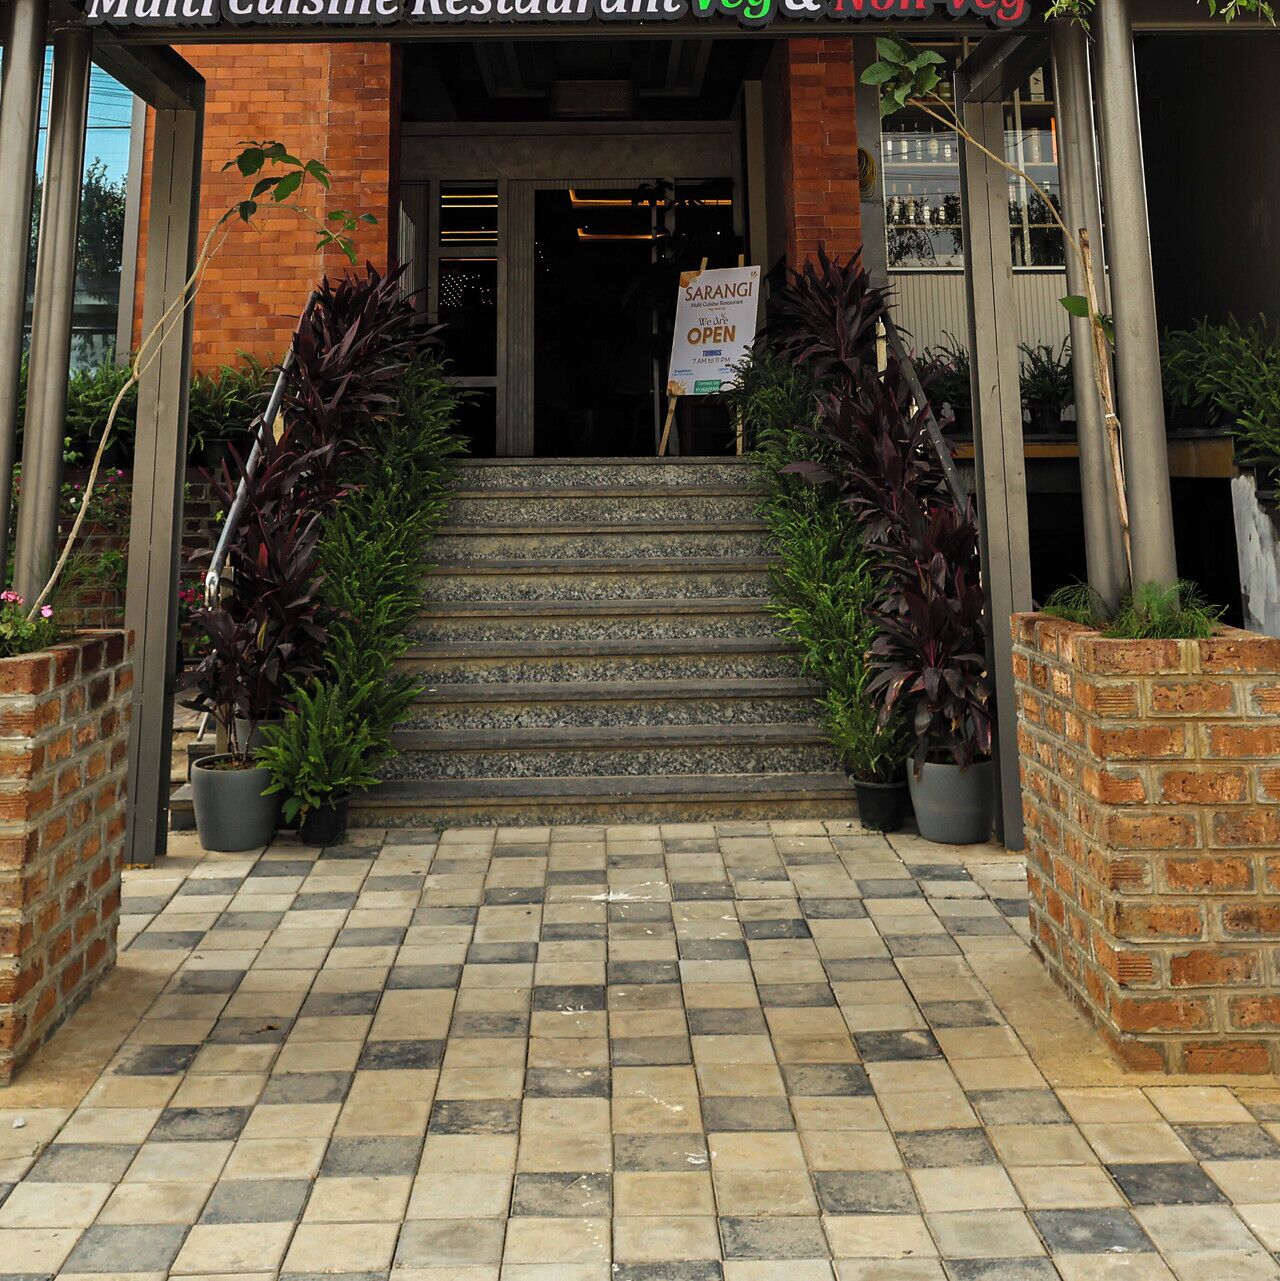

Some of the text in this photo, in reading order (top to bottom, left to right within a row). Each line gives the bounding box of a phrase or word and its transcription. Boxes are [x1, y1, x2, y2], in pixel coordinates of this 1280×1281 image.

[685, 282, 753, 302] SARANGI
[699, 317, 728, 326] We Are
[687, 325, 736, 345] OPEN
